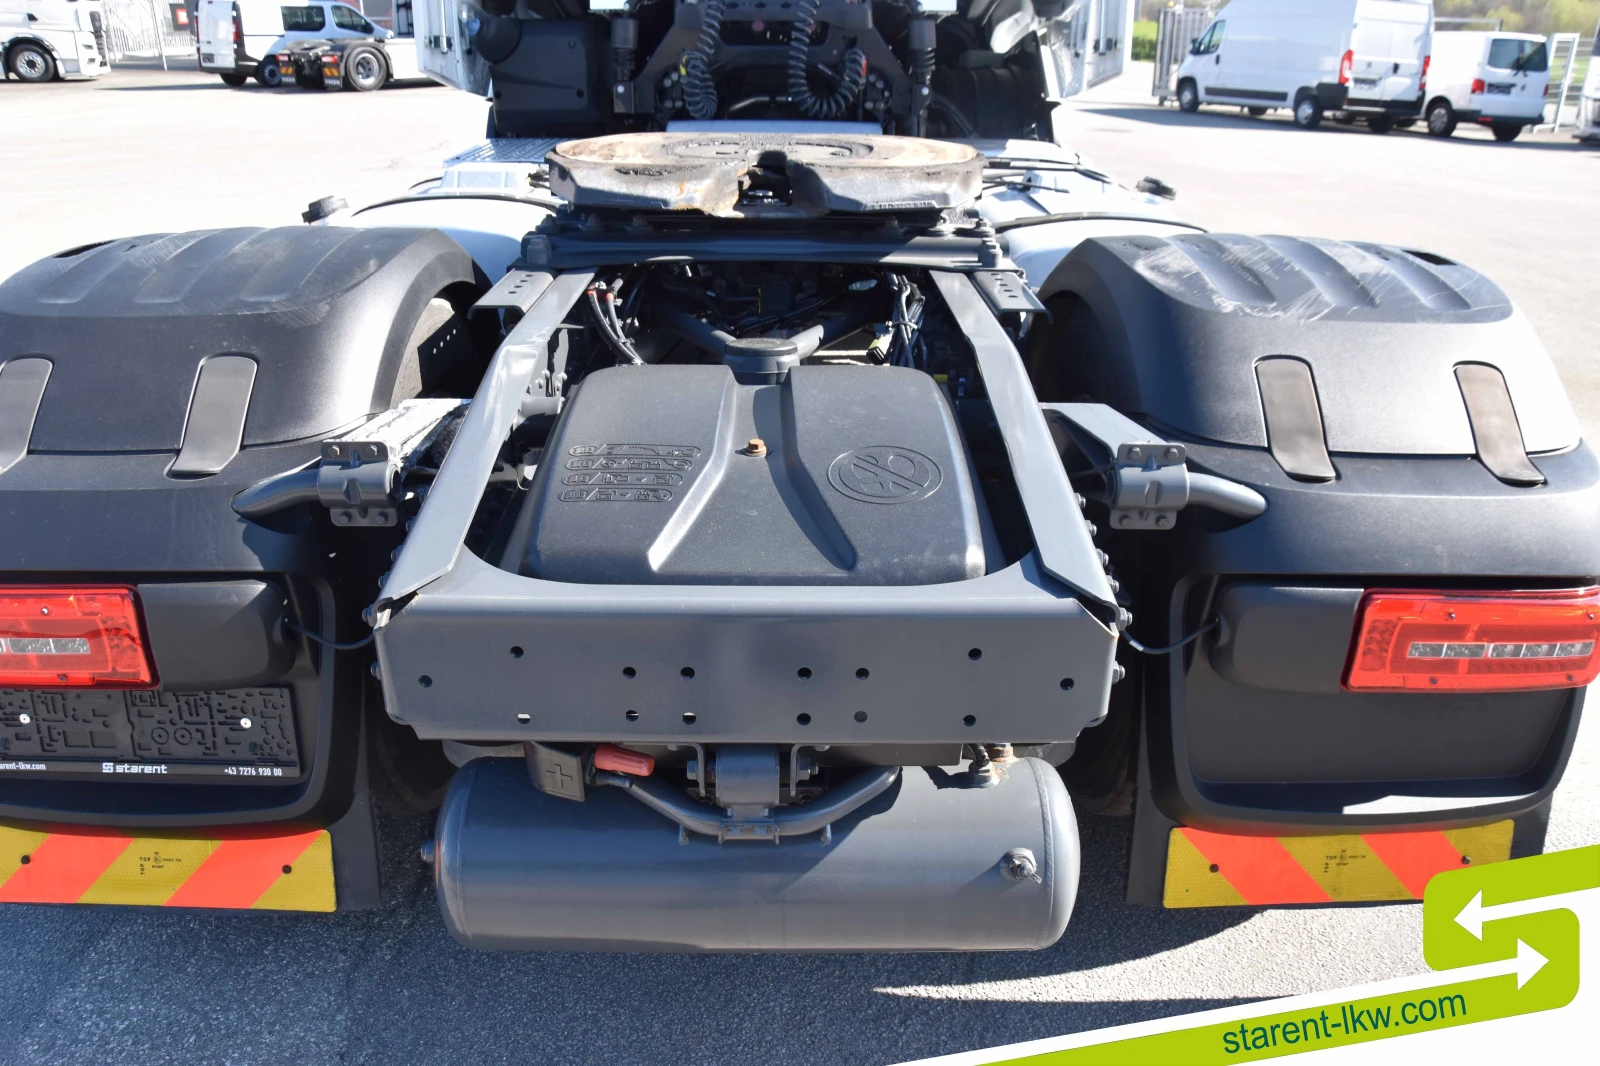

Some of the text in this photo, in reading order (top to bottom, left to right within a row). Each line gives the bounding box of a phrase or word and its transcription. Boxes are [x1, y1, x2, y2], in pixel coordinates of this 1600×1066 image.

[115, 763, 167, 774] starent
[224, 766, 282, 776] +43 7276 930 00
